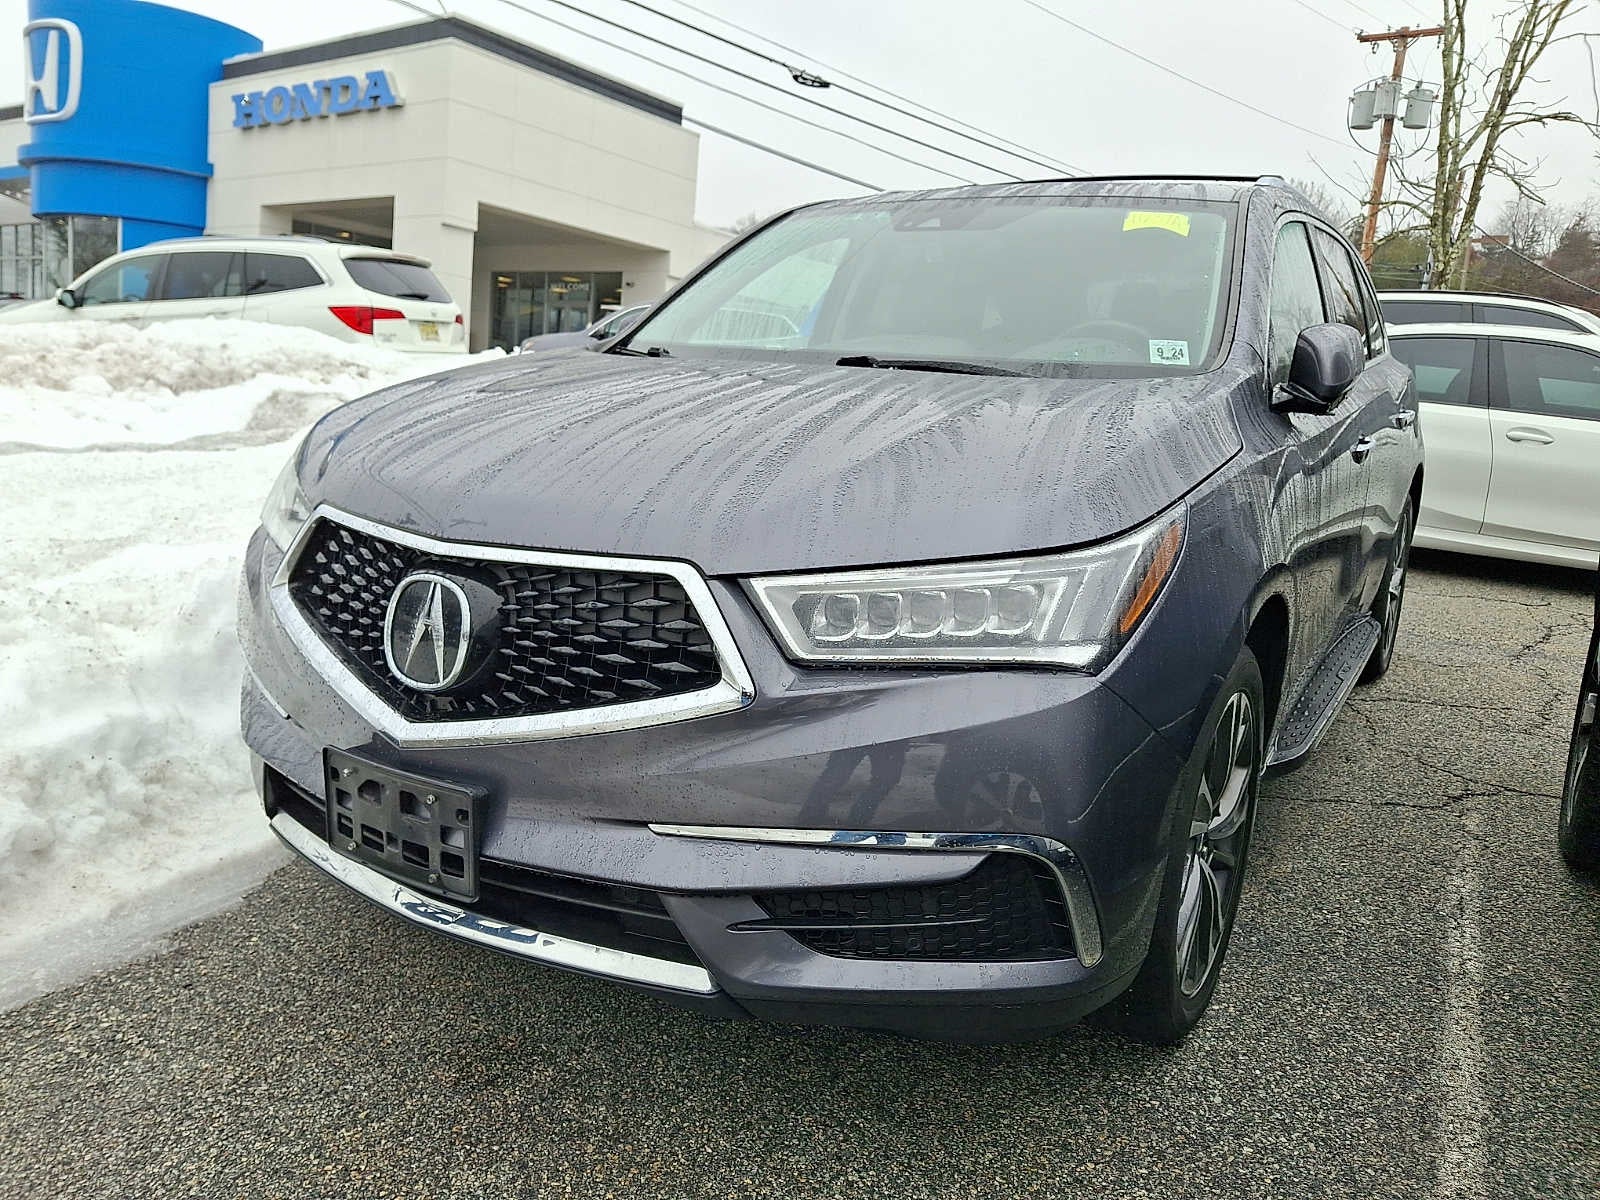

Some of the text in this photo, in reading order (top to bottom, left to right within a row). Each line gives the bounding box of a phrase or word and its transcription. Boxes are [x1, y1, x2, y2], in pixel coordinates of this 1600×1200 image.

[231, 69, 399, 128] HONDA
[1156, 347, 1184, 358] 9 24
